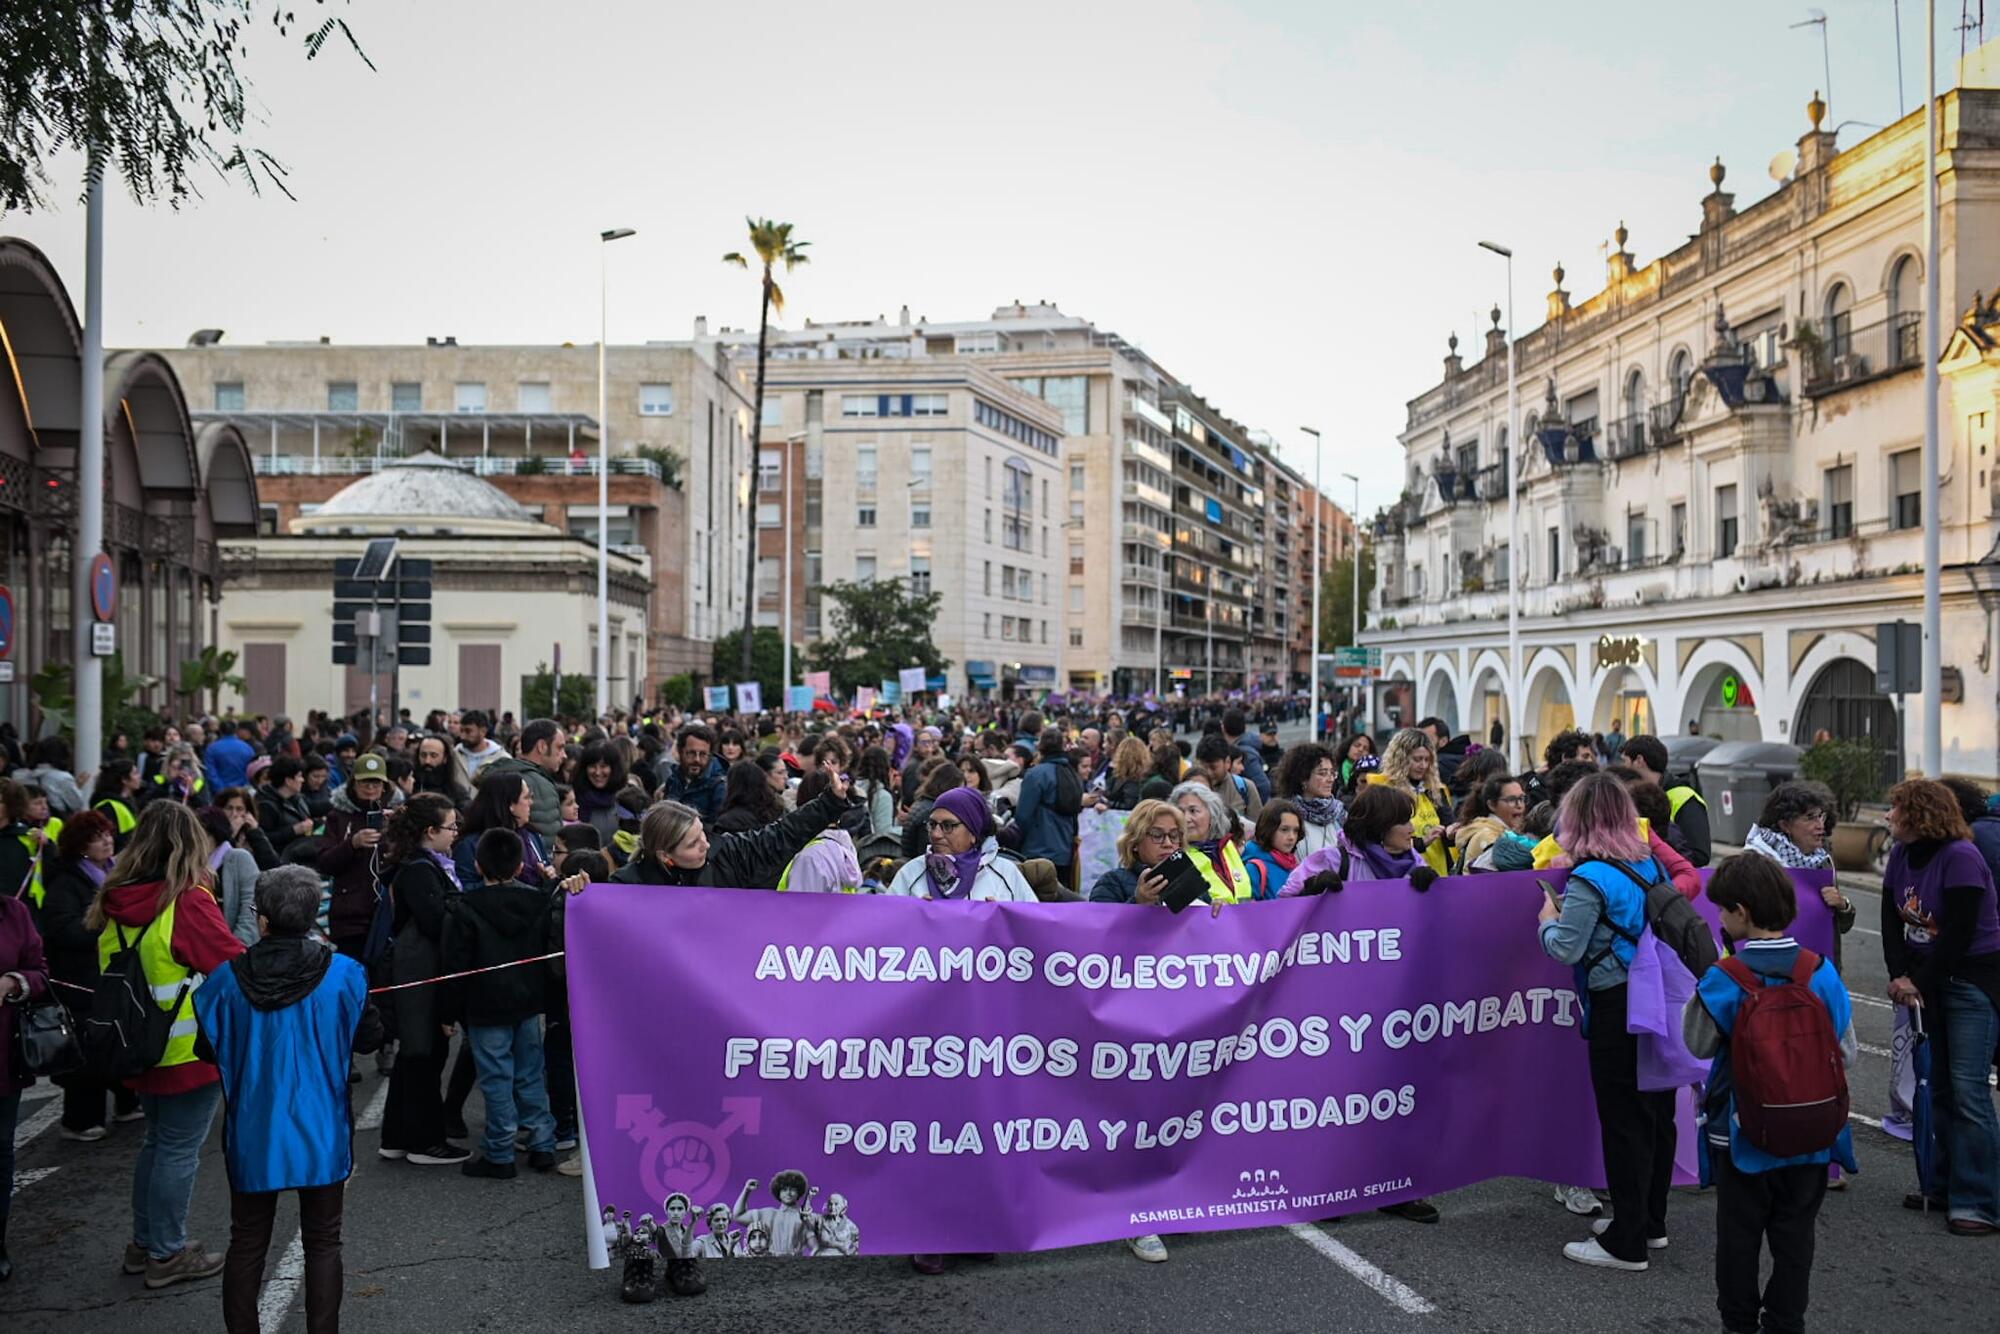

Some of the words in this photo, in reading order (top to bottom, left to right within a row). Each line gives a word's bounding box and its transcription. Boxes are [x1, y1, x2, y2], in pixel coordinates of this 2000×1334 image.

[754, 944, 1035, 982] AVANZAMOS
[724, 1034, 1079, 1080] FEMINISMOS
[1090, 1015, 1331, 1081] DIVERSOS
[1339, 1013, 1373, 1053] Y
[1382, 987, 1585, 1050] COMBATI
[823, 1120, 917, 1156] POR
[928, 1120, 984, 1156] LA
[992, 1117, 1090, 1155] VIDA
[1098, 1119, 1128, 1151] Y
[1134, 1109, 1204, 1150] LOS
[1210, 1084, 1416, 1136] CUIDADOS
[1129, 1206, 1205, 1225] ASAMBLEA
[1208, 1198, 1288, 1217] FEMINISTA
[1291, 1188, 1358, 1209] UNITARIA
[1363, 1176, 1413, 1198] SEVILLA
